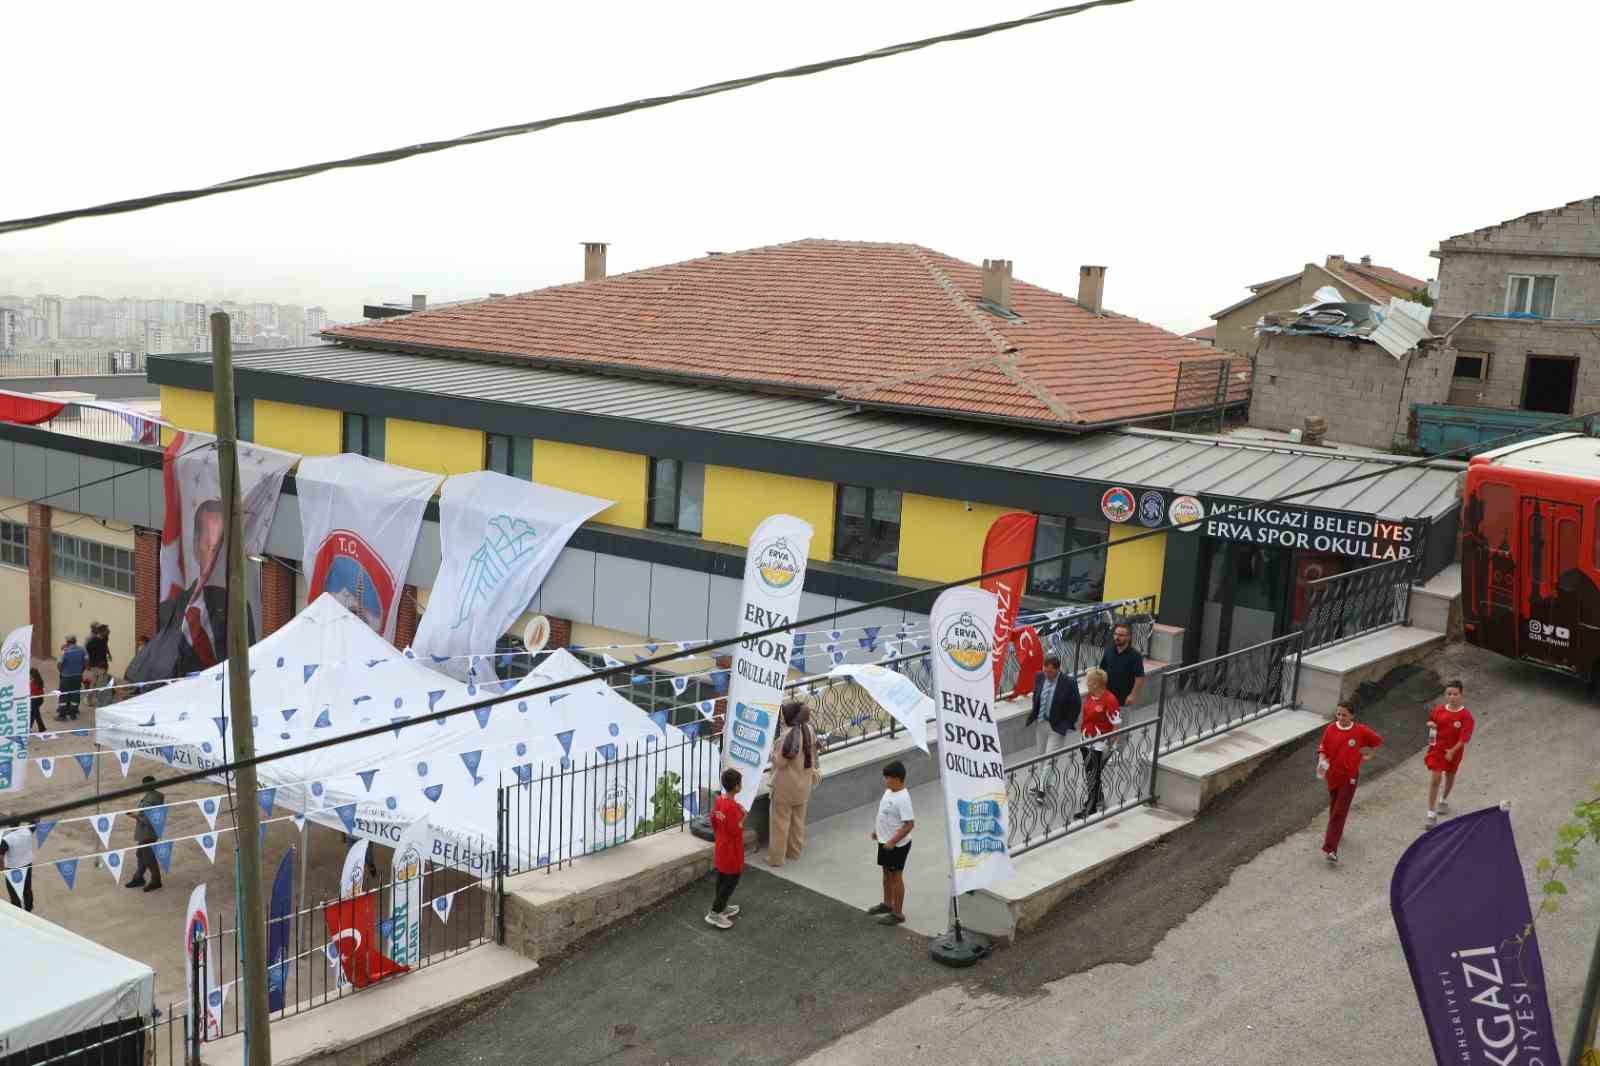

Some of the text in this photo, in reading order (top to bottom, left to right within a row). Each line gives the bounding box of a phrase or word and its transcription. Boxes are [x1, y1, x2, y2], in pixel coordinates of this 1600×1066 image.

[1207, 520, 1253, 541] ERVA
[1257, 527, 1309, 549] SPOR
[769, 549, 789, 560] ERVA
[744, 603, 792, 635] ERVA
[955, 627, 977, 639] ERVA
[737, 658, 785, 691] OKULLARI
[941, 690, 994, 724] ERVA
[944, 723, 1000, 753] SPOR
[946, 752, 1003, 779] OKULLARI
